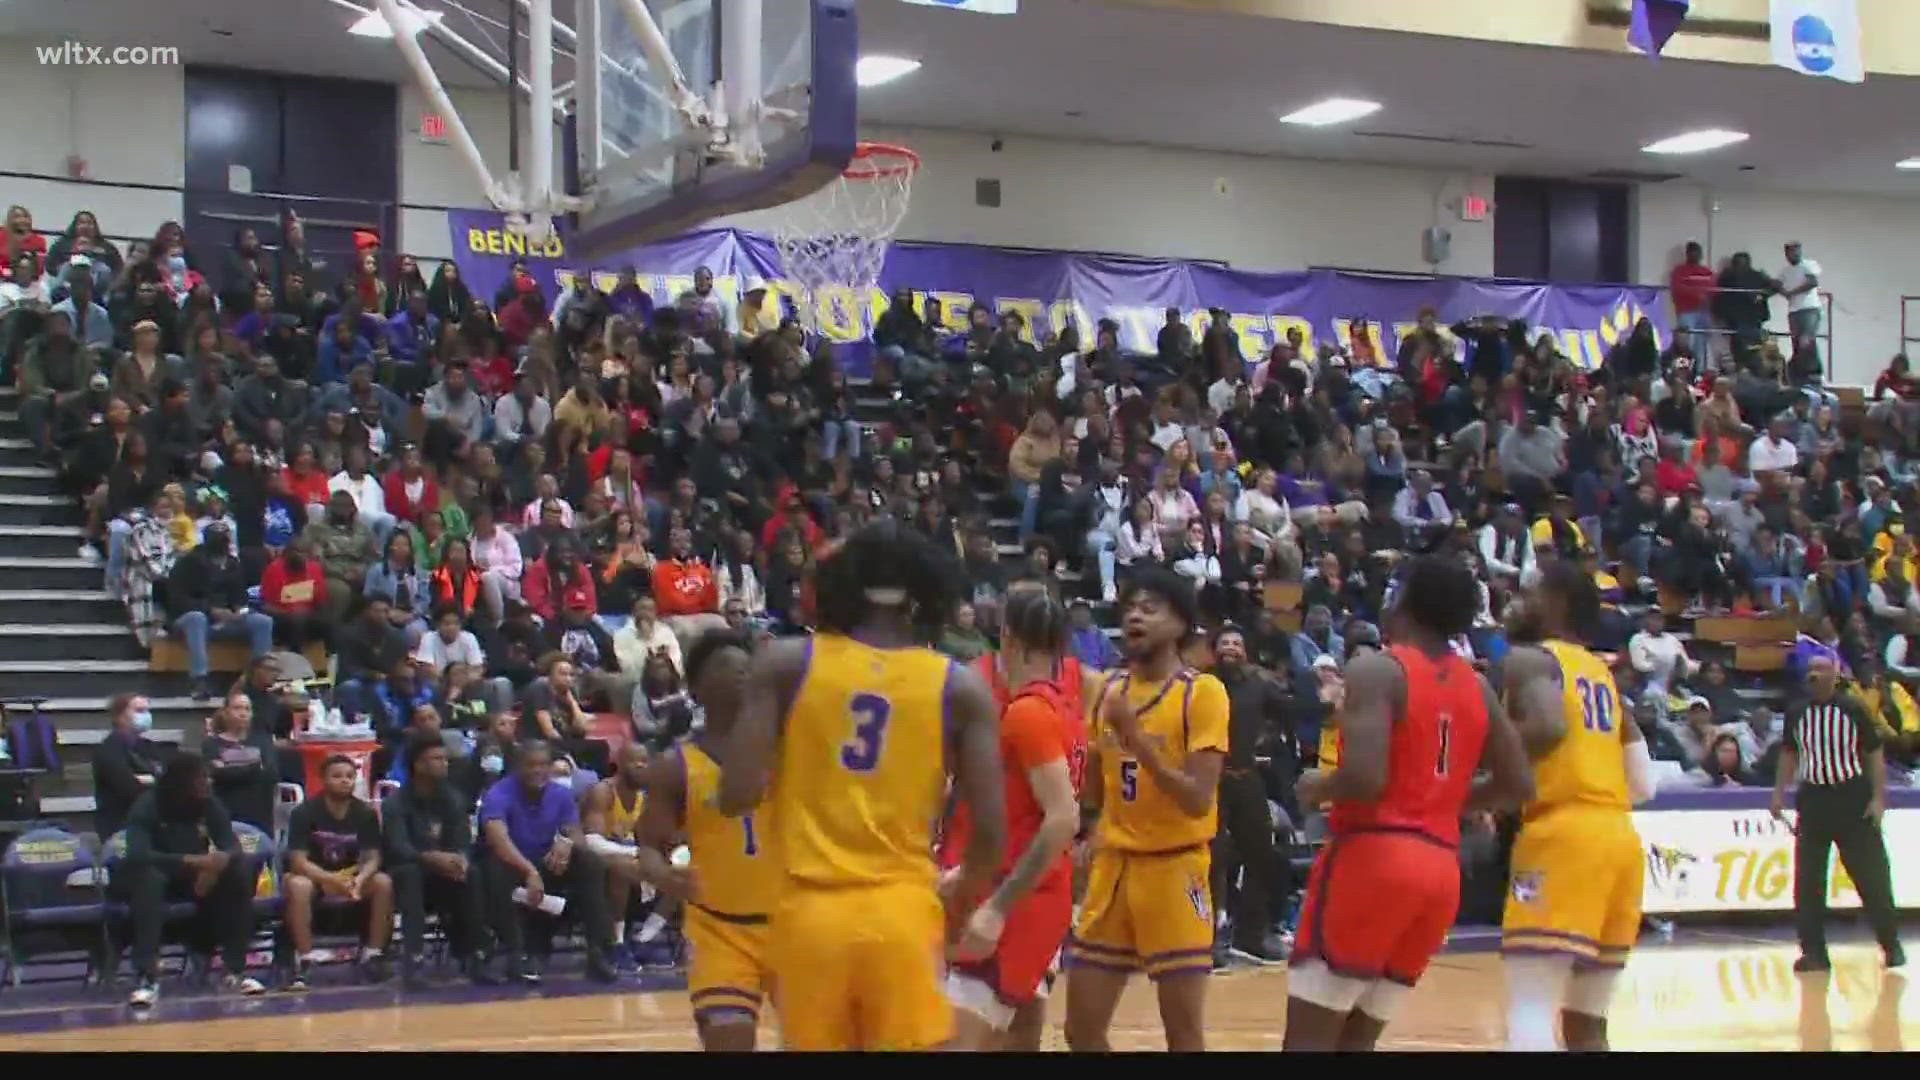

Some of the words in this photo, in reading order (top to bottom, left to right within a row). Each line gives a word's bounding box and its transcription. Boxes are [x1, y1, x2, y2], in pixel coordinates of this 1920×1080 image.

[841, 692, 892, 772] 3
[1576, 676, 1614, 733] 30
[1435, 714, 1450, 777] 1
[1120, 758, 1138, 803] 5
